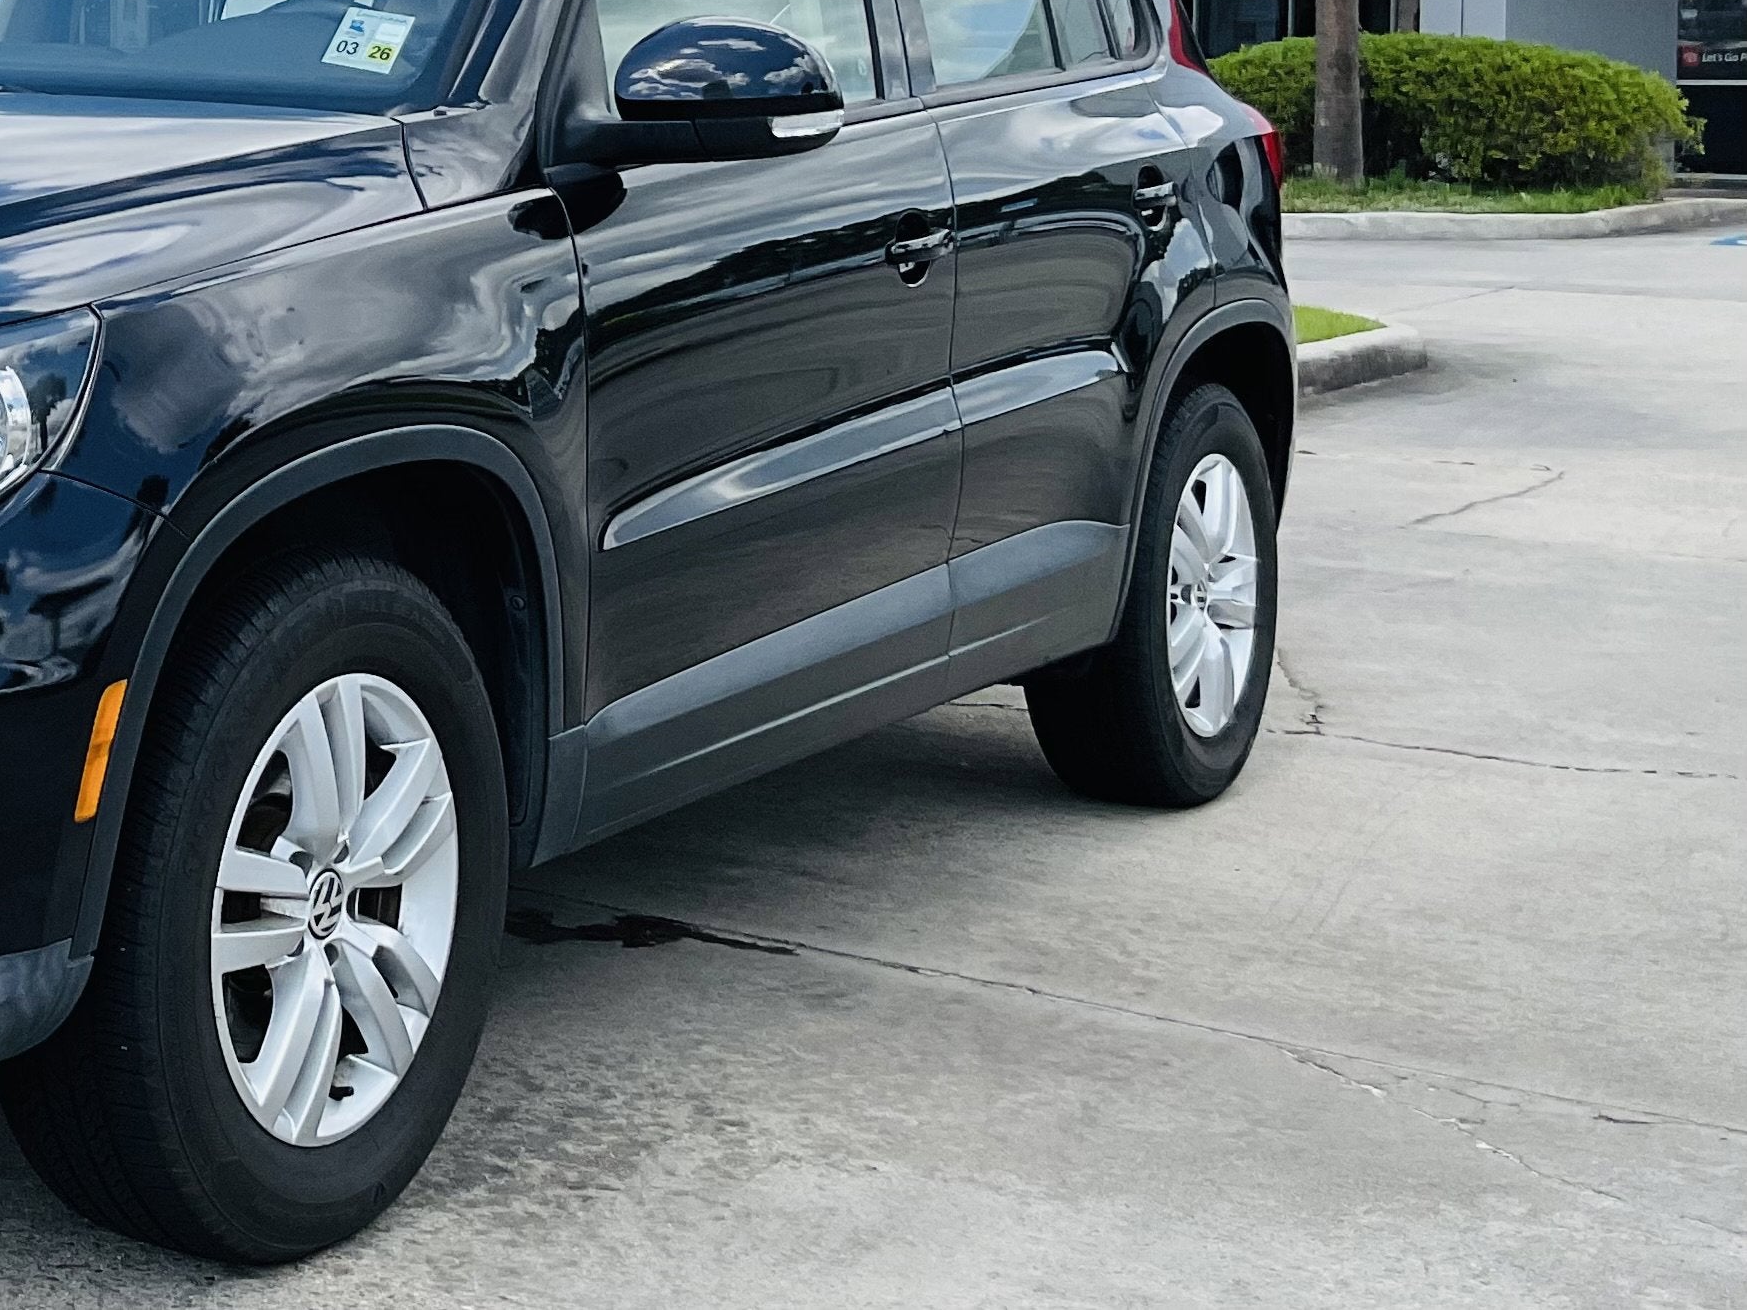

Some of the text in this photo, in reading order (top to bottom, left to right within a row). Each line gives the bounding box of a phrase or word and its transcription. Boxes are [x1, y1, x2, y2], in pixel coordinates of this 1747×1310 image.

[336, 40, 392, 61] 03 26
[1701, 52, 1723, 63] Let's
